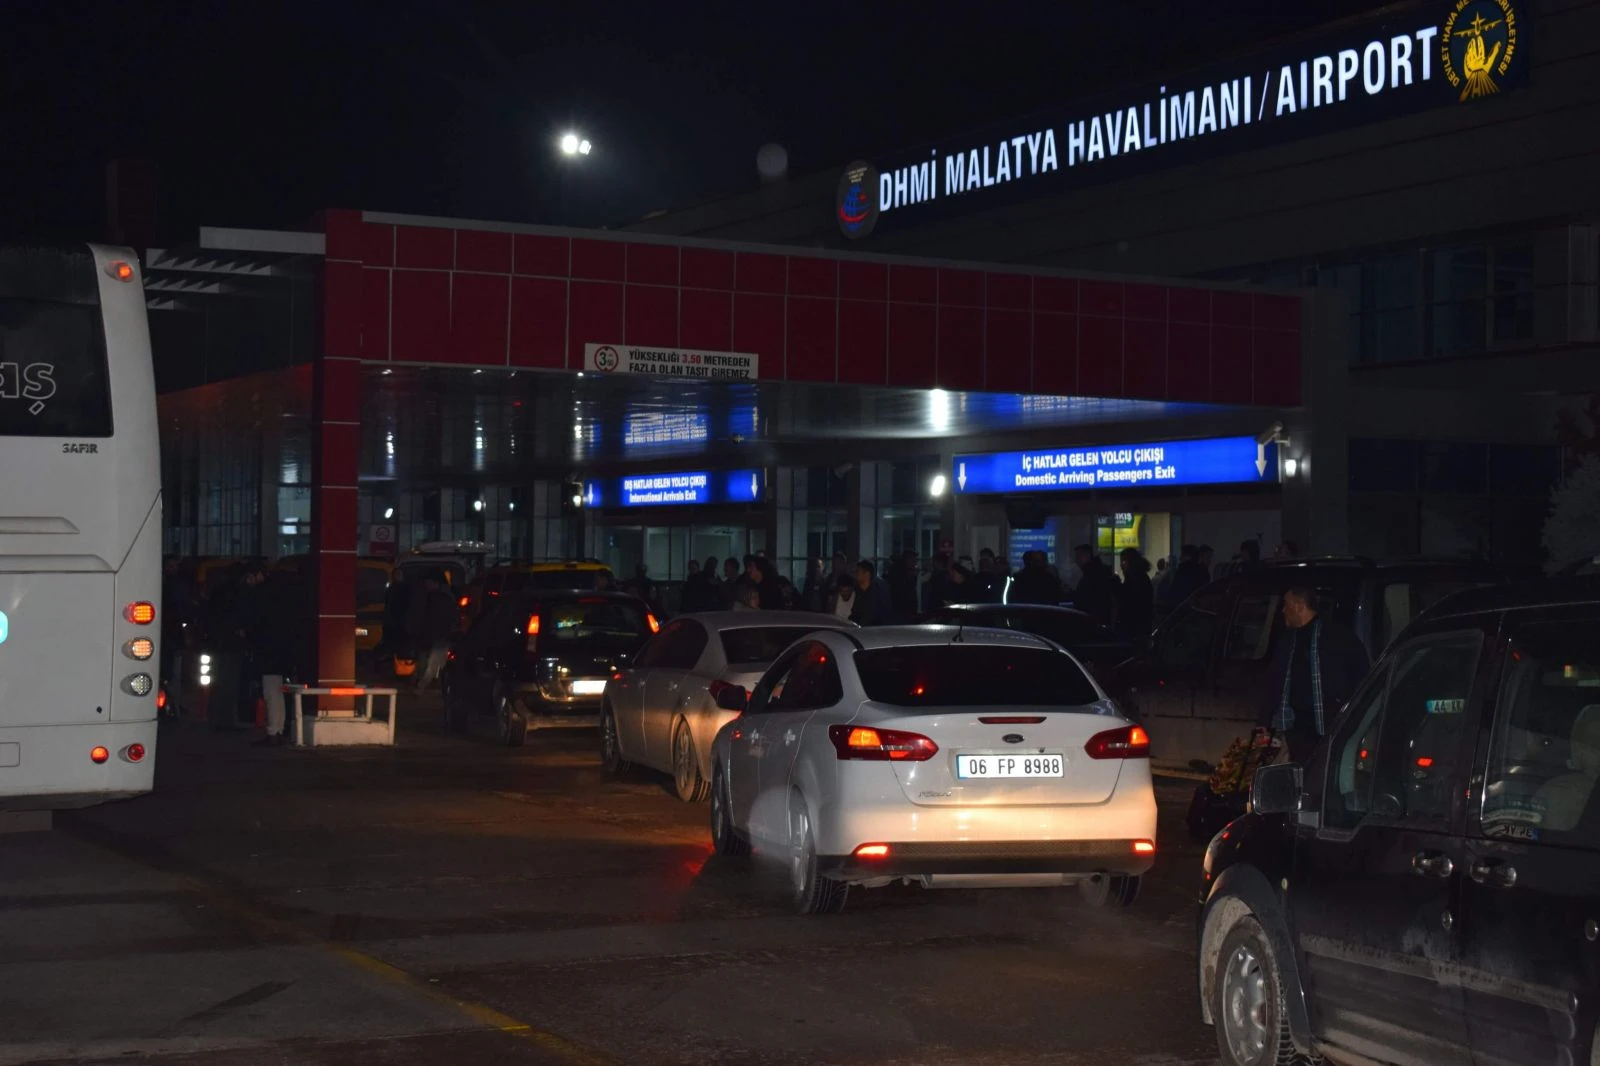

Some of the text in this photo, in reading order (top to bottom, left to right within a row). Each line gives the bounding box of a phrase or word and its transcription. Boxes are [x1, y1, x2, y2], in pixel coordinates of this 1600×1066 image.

[1441, 11, 1459, 42] HAVA
[1441, 46, 1461, 87] DEVLET
[879, 149, 938, 212] DHMİ
[945, 128, 1058, 196] MALATYA
[1276, 26, 1438, 116] AIRPORT
[629, 363, 656, 373] FAZLA
[659, 364, 683, 375] OLAN
[682, 354, 701, 364] 3.50
[704, 355, 750, 367] METREDEN
[1022, 447, 1164, 472] İÇ HATLAR GELEN YOLCU ÇIKIŞI
[1015, 465, 1176, 486] Domestic Arriving Passengers Exit
[629, 489, 697, 503] International Arrivals Exit
[969, 759, 1060, 775] 06 FP 8988
